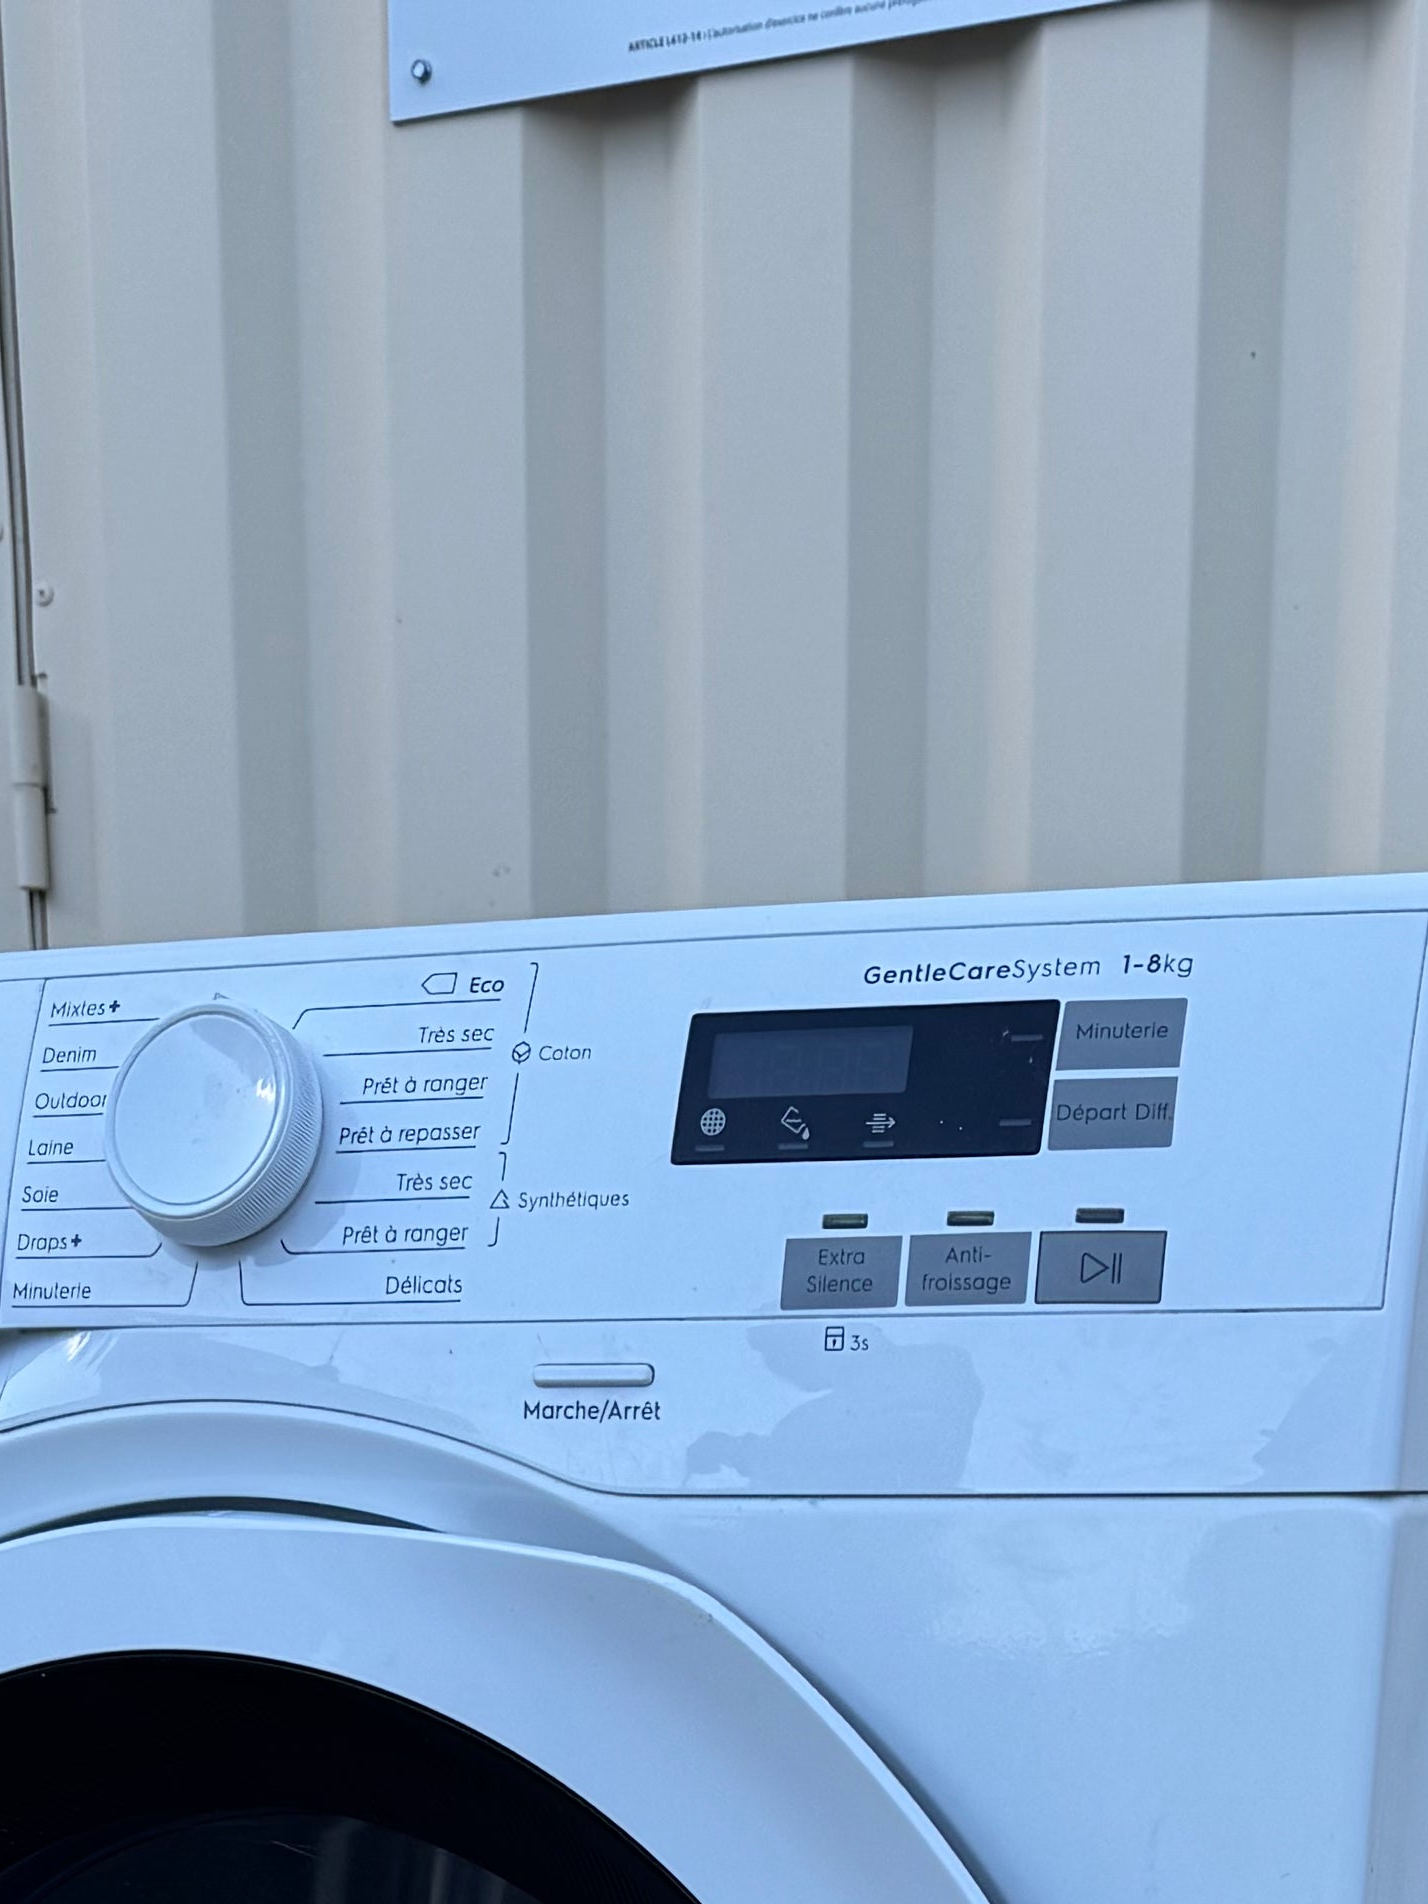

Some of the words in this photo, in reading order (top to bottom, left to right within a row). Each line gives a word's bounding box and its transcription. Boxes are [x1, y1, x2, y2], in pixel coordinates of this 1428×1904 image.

[863, 957, 1101, 985] GentleCareSystem
[1123, 953, 1194, 978] 1-8kg
[469, 976, 505, 994] Eco
[419, 1026, 455, 1044] Très
[461, 1027, 495, 1043] sec
[1076, 1021, 1169, 1040] Minuterie
[42, 1046, 97, 1064] Denim
[538, 1045, 592, 1062] Coton
[362, 1076, 399, 1096] Prêt
[404, 1075, 417, 1094] à
[423, 1076, 489, 1096] ranger
[1056, 1102, 1127, 1125] Départ
[1135, 1102, 1173, 1121] Diff.
[338, 1126, 374, 1146] Prêt
[379, 1125, 393, 1144] à
[398, 1125, 482, 1146] repasser
[28, 1139, 74, 1156] Laine
[396, 1172, 433, 1192] Très
[439, 1175, 473, 1191] sec
[21, 1185, 59, 1204] Soie
[517, 1191, 630, 1213] Synthétiques
[342, 1225, 379, 1246] Prêt
[385, 1224, 398, 1244] à
[404, 1226, 469, 1247] ranger
[818, 1248, 865, 1266] Extra
[944, 1245, 992, 1264] Anti-
[12, 1282, 92, 1300] Minuterie
[385, 1274, 463, 1295] Délicats
[806, 1274, 873, 1294] Silence
[922, 1273, 1012, 1295] froissage
[849, 1334, 869, 1352] 3s
[523, 1399, 661, 1424] Marche/Arrêt
